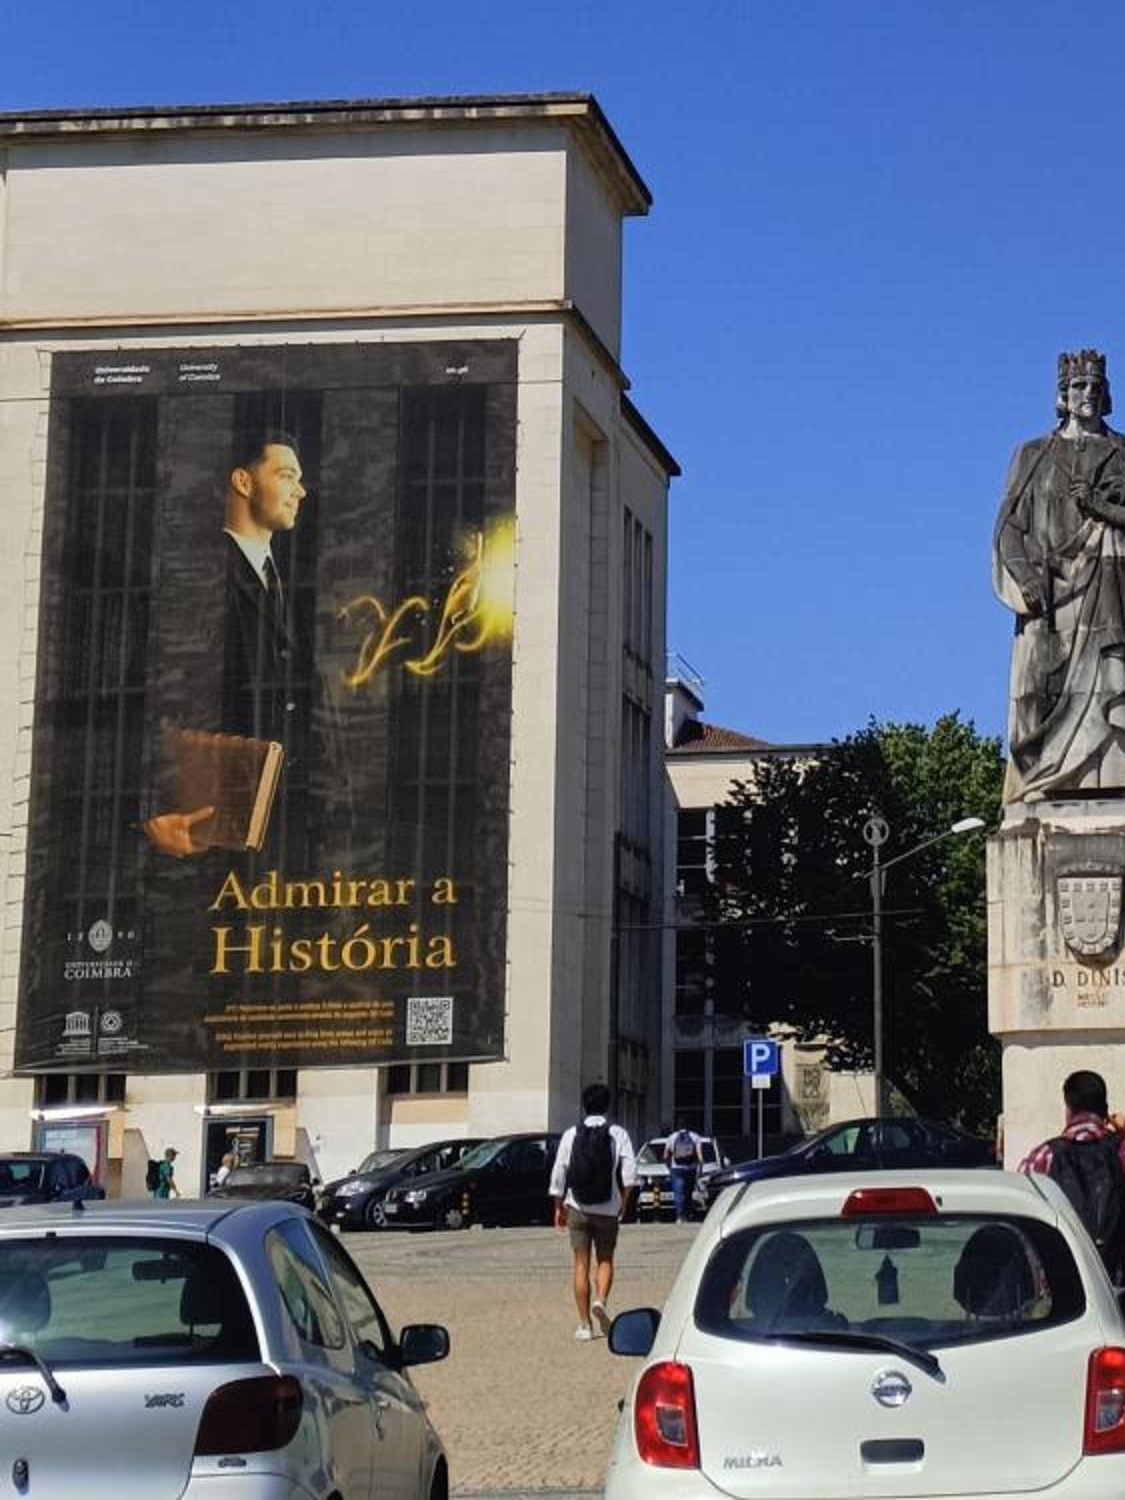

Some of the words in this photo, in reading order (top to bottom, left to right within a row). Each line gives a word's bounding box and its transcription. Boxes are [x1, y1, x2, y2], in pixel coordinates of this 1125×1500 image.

[208, 870, 415, 911] Admirar
[432, 876, 459, 904] a
[209, 923, 457, 974] História
[751, 1043, 771, 1073] P
